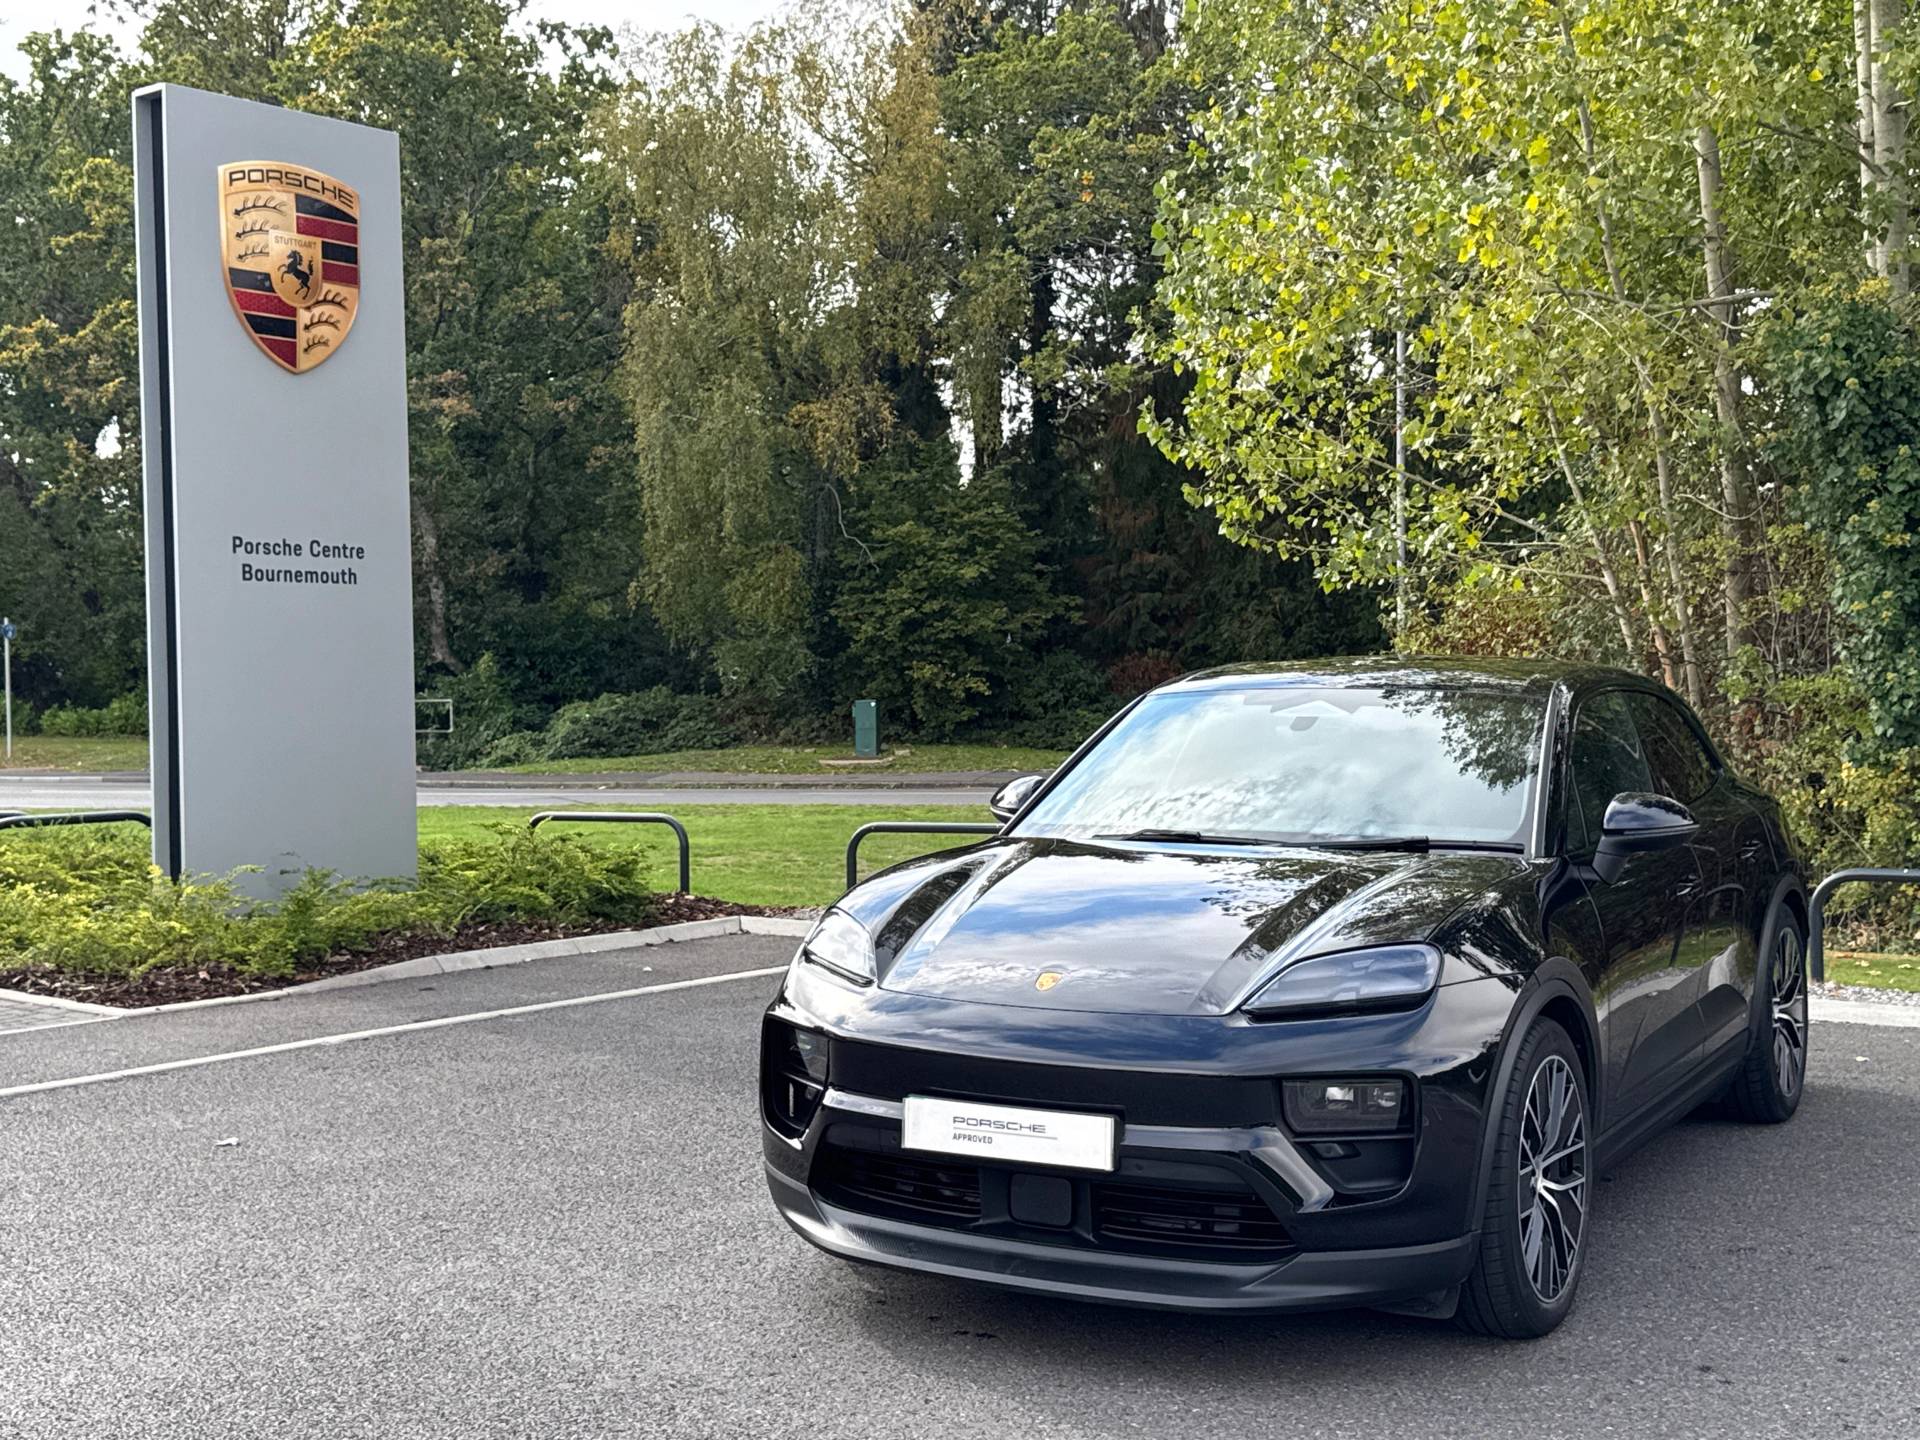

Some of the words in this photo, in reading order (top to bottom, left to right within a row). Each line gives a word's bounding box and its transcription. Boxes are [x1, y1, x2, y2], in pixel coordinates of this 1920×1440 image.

[228, 168, 354, 209] PORSCHE
[274, 235, 317, 249] STUTTGART
[232, 536, 303, 557] Porsche
[309, 540, 365, 560] Centre
[242, 563, 358, 585] Bournemouth
[952, 1116, 1046, 1134] PORSCHE
[952, 1133, 993, 1145] APPROVED
